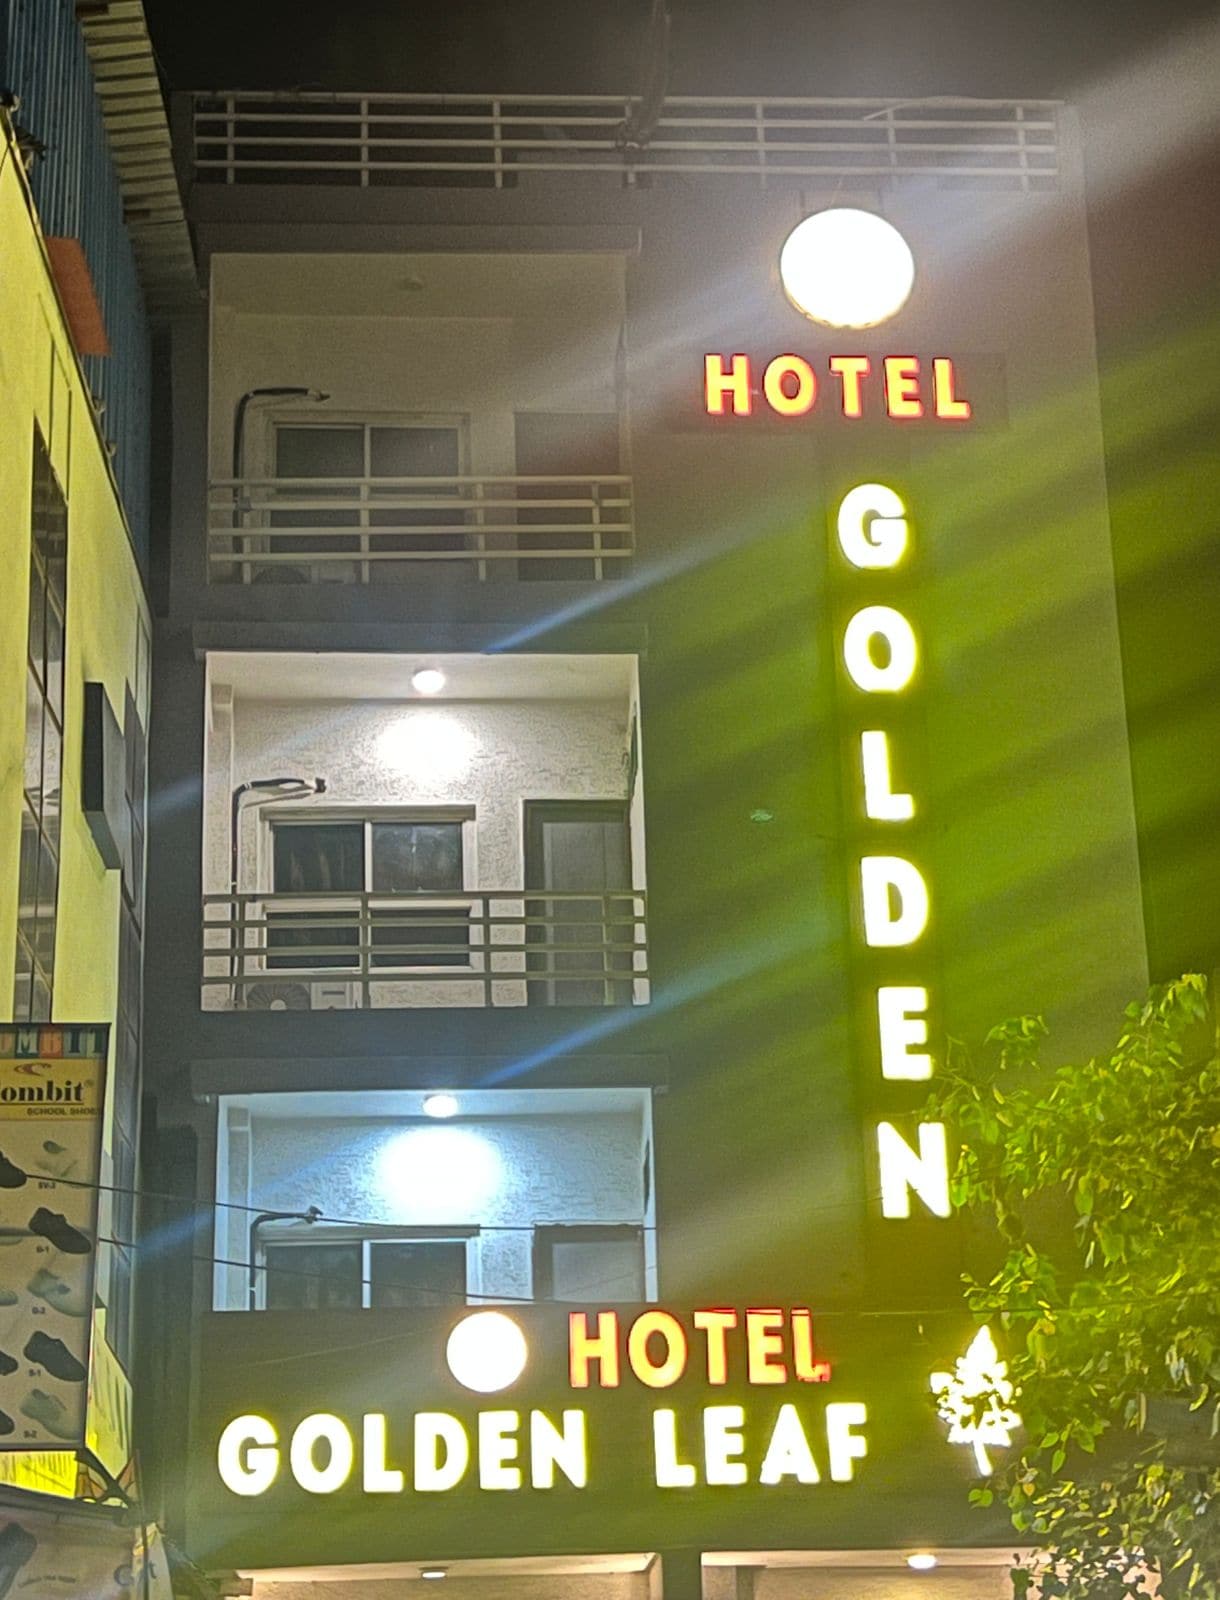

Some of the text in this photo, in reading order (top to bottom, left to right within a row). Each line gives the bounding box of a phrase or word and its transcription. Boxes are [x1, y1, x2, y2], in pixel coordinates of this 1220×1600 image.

[704, 353, 971, 419] HOTEL
[838, 483, 951, 1219] GOLDEN
[0, 1080, 84, 1101] ombit
[27, 1107, 67, 1116] SCHOOL
[569, 1309, 831, 1388] HOTEL
[217, 1402, 868, 1496] GOLDEN LEAF
